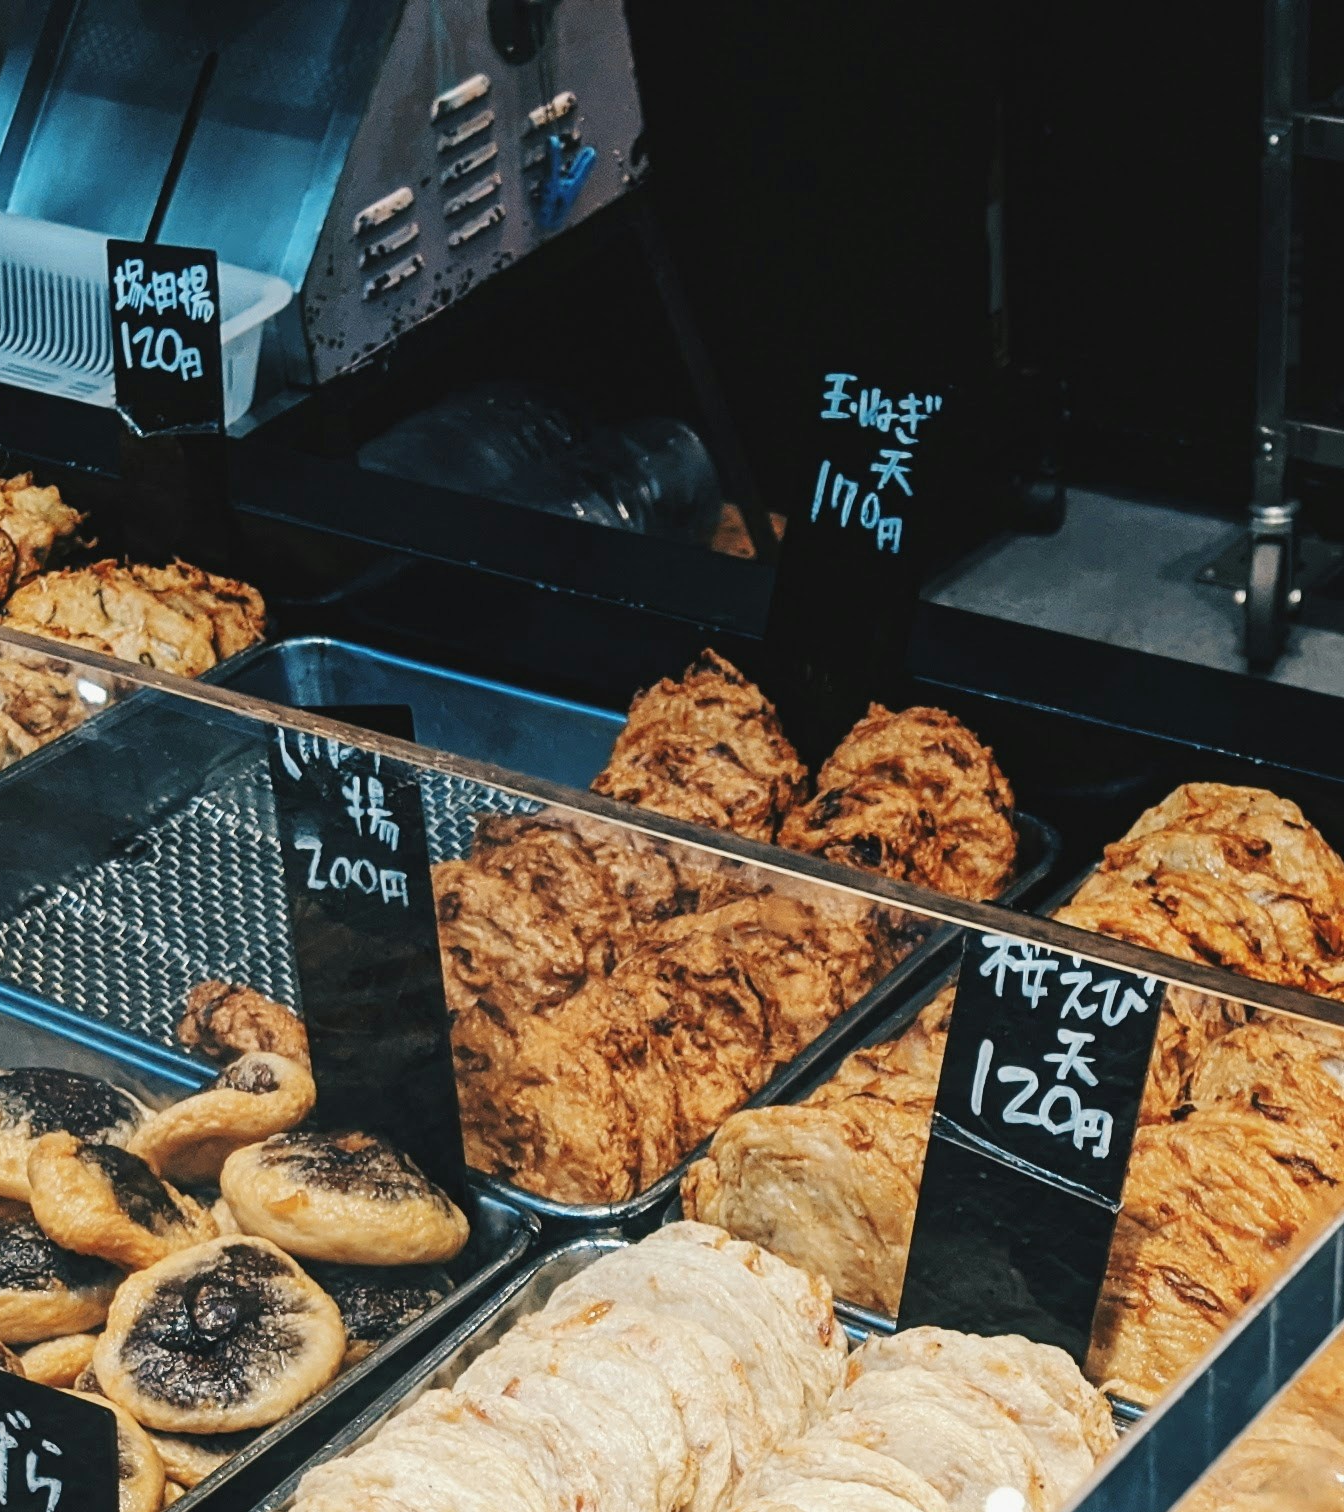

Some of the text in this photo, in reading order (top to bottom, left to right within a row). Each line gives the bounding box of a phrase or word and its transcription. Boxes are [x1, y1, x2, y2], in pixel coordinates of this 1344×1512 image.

[121, 322, 203, 381] 120円
[294, 836, 409, 907] 200円
[971, 1039, 1113, 1159] 120円
